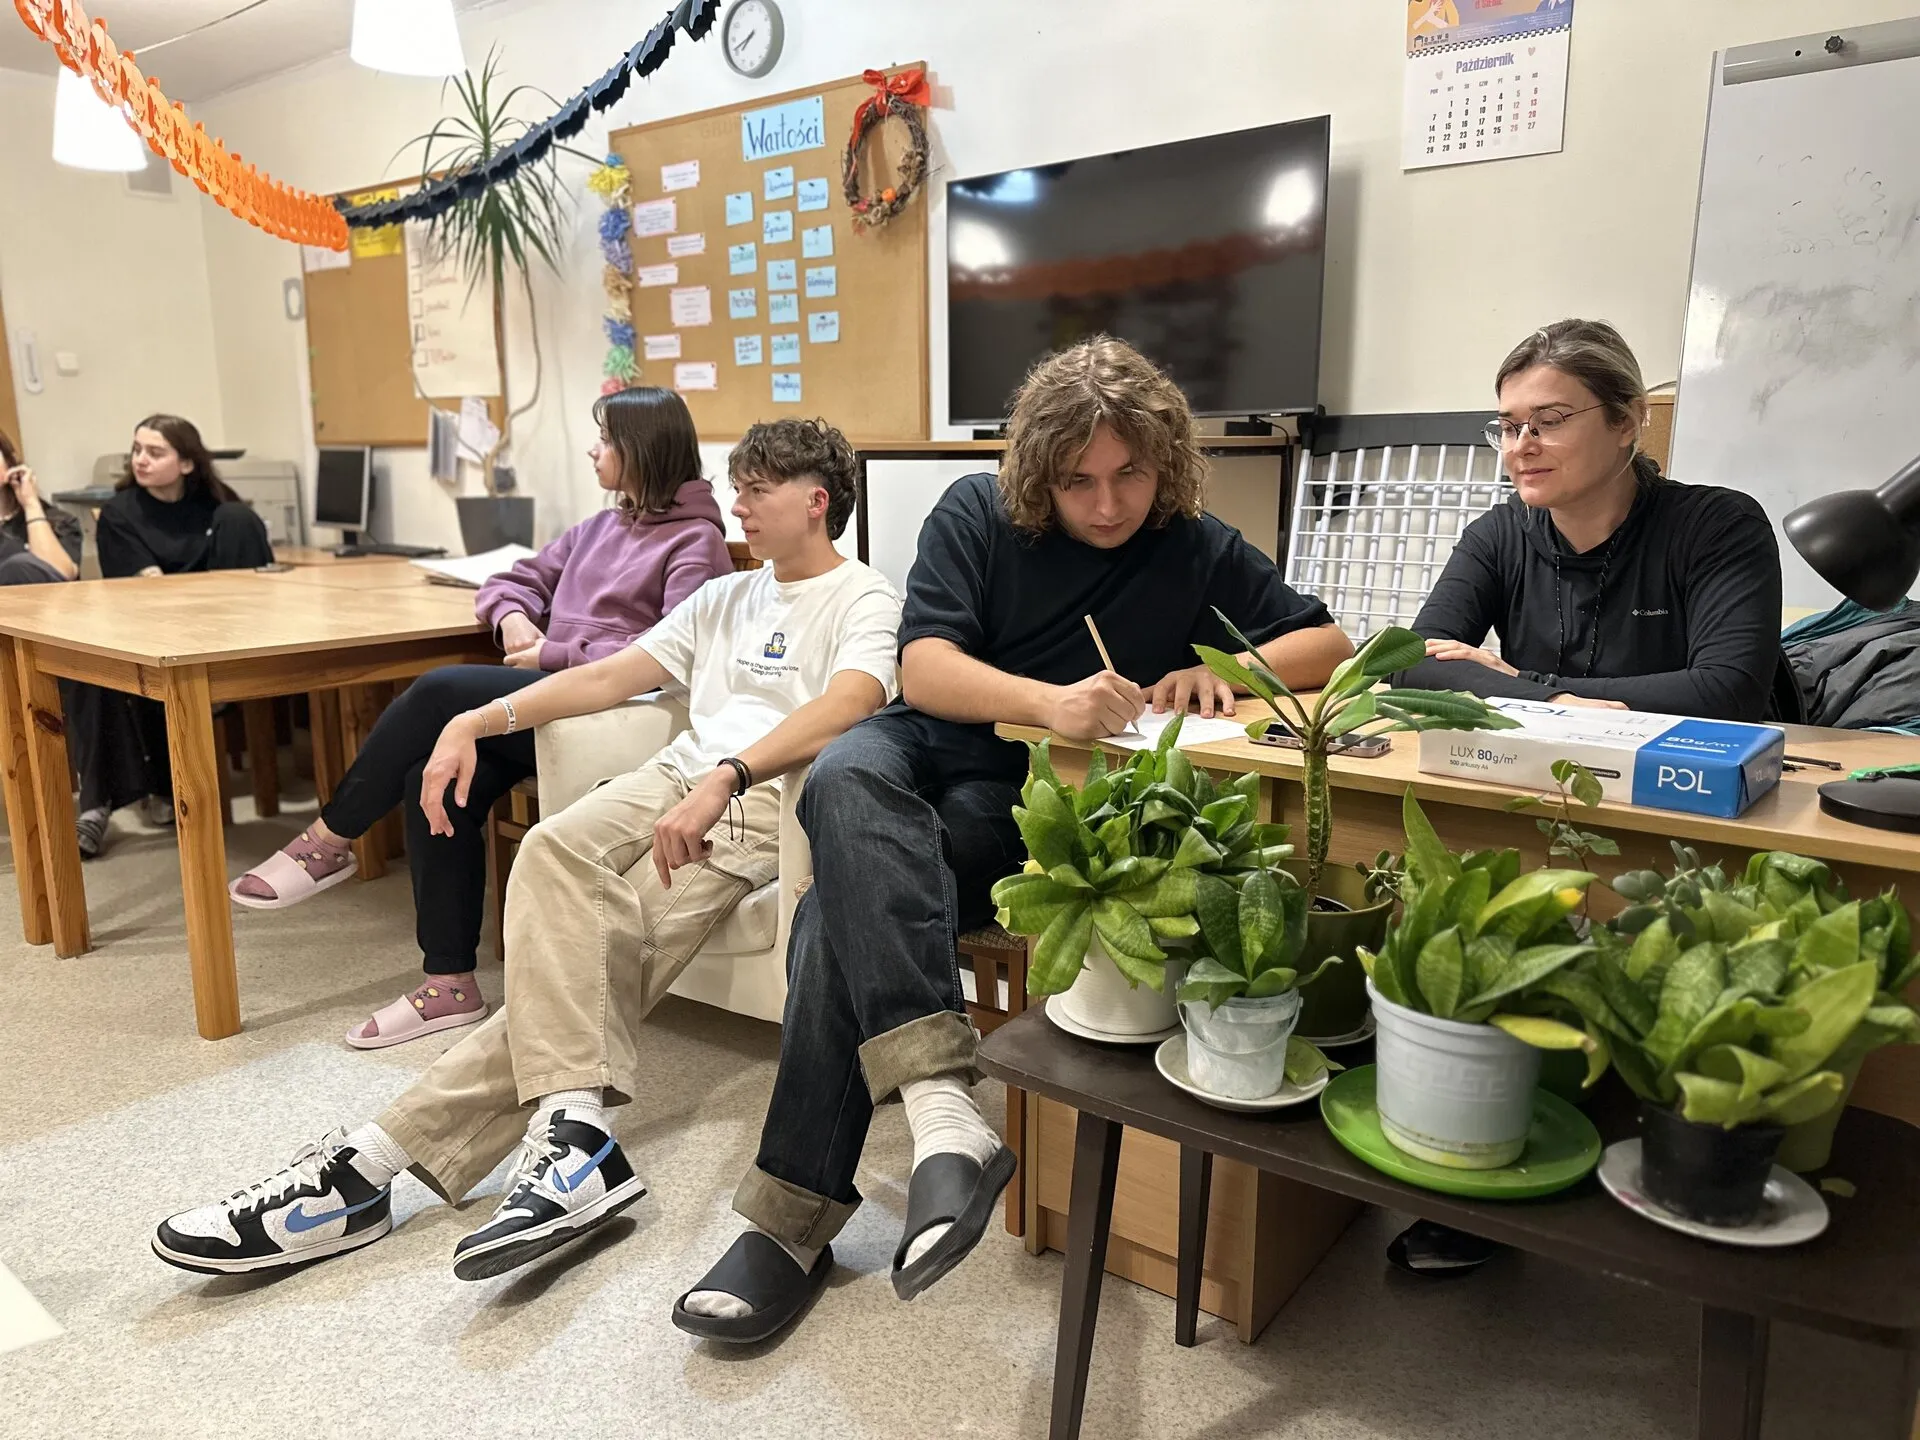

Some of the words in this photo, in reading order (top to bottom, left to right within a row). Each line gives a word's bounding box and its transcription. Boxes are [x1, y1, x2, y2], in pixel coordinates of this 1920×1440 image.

[1480, 106, 1486, 114] 10
[1513, 101, 1520, 109] 12
[1531, 99, 1537, 107] 13
[1482, 95, 1487, 103] 3
[1462, 120, 1468, 128] 16
[1479, 118, 1485, 126] 17
[1496, 115, 1502, 123] 18
[1528, 110, 1536, 119] 20
[747, 113, 819, 155] Wartości
[1443, 133, 1450, 141] 22
[1460, 131, 1467, 139] 23
[1476, 129, 1484, 137] 24
[1493, 126, 1501, 134] 25
[1510, 124, 1518, 132] 26
[1528, 122, 1536, 130] 27
[1426, 146, 1434, 154] 28
[1442, 144, 1450, 152] 29
[1459, 142, 1466, 150] 30
[1476, 140, 1483, 148] 31
[1500, 703, 1574, 718] POL
[1604, 729, 1650, 739] LUX
[1450, 745, 1474, 759] LUX
[1449, 759, 1460, 767] 500
[1657, 765, 1712, 795] POL
